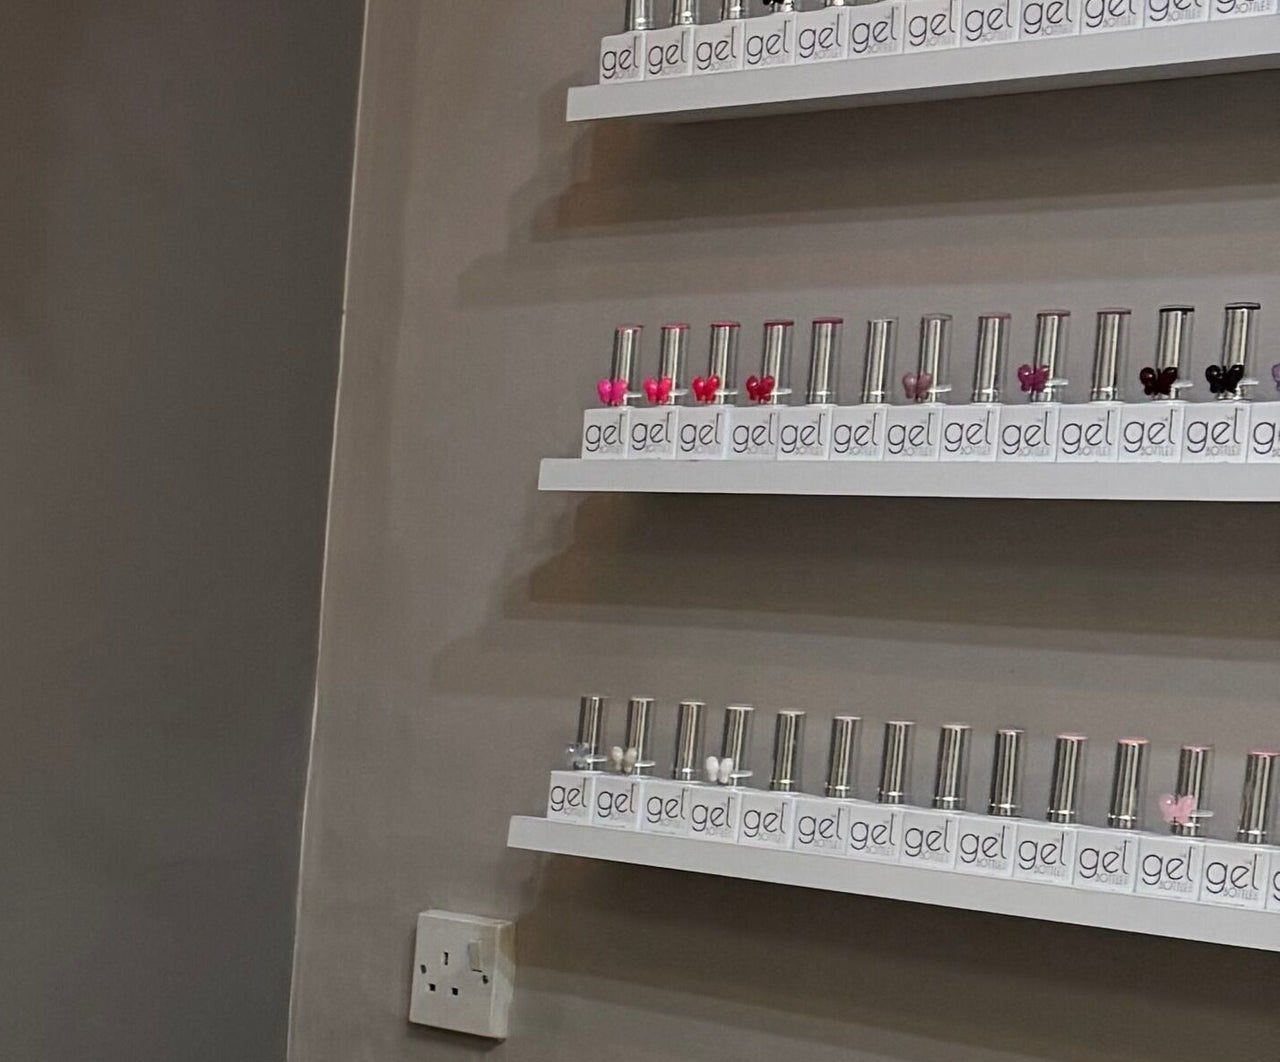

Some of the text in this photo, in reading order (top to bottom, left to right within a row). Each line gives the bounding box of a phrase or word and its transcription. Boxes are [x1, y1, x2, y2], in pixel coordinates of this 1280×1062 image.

[799, 14, 842, 58] gel
[852, 7, 897, 53] gel
[909, 0, 956, 46] gel
[965, 0, 1012, 41] gel
[602, 36, 638, 79] gel
[648, 31, 687, 74] gel
[697, 26, 737, 70] gel
[747, 20, 790, 65] gel
[586, 413, 624, 452] gel
[632, 412, 672, 452] gel
[680, 413, 722, 452] gel
[732, 413, 774, 454] gel
[781, 413, 825, 454] gel
[834, 413, 879, 454] gel
[887, 412, 933, 455] gel
[944, 410, 992, 452] gel
[1002, 411, 1052, 455] gel
[1061, 409, 1112, 455] gel
[1124, 408, 1176, 453] gel
[1186, 407, 1241, 453] gel
[550, 778, 587, 812] gel
[597, 784, 636, 818] gel
[647, 788, 687, 823] gel
[692, 797, 733, 832] gel
[744, 802, 787, 838] gel
[798, 808, 843, 844] gel
[851, 813, 895, 850] gel
[905, 819, 950, 857] gel
[960, 826, 1007, 863] gel
[1018, 832, 1067, 870] gel
[1079, 840, 1130, 879] gel
[1142, 847, 1195, 887] gel
[1206, 853, 1259, 894] gel
